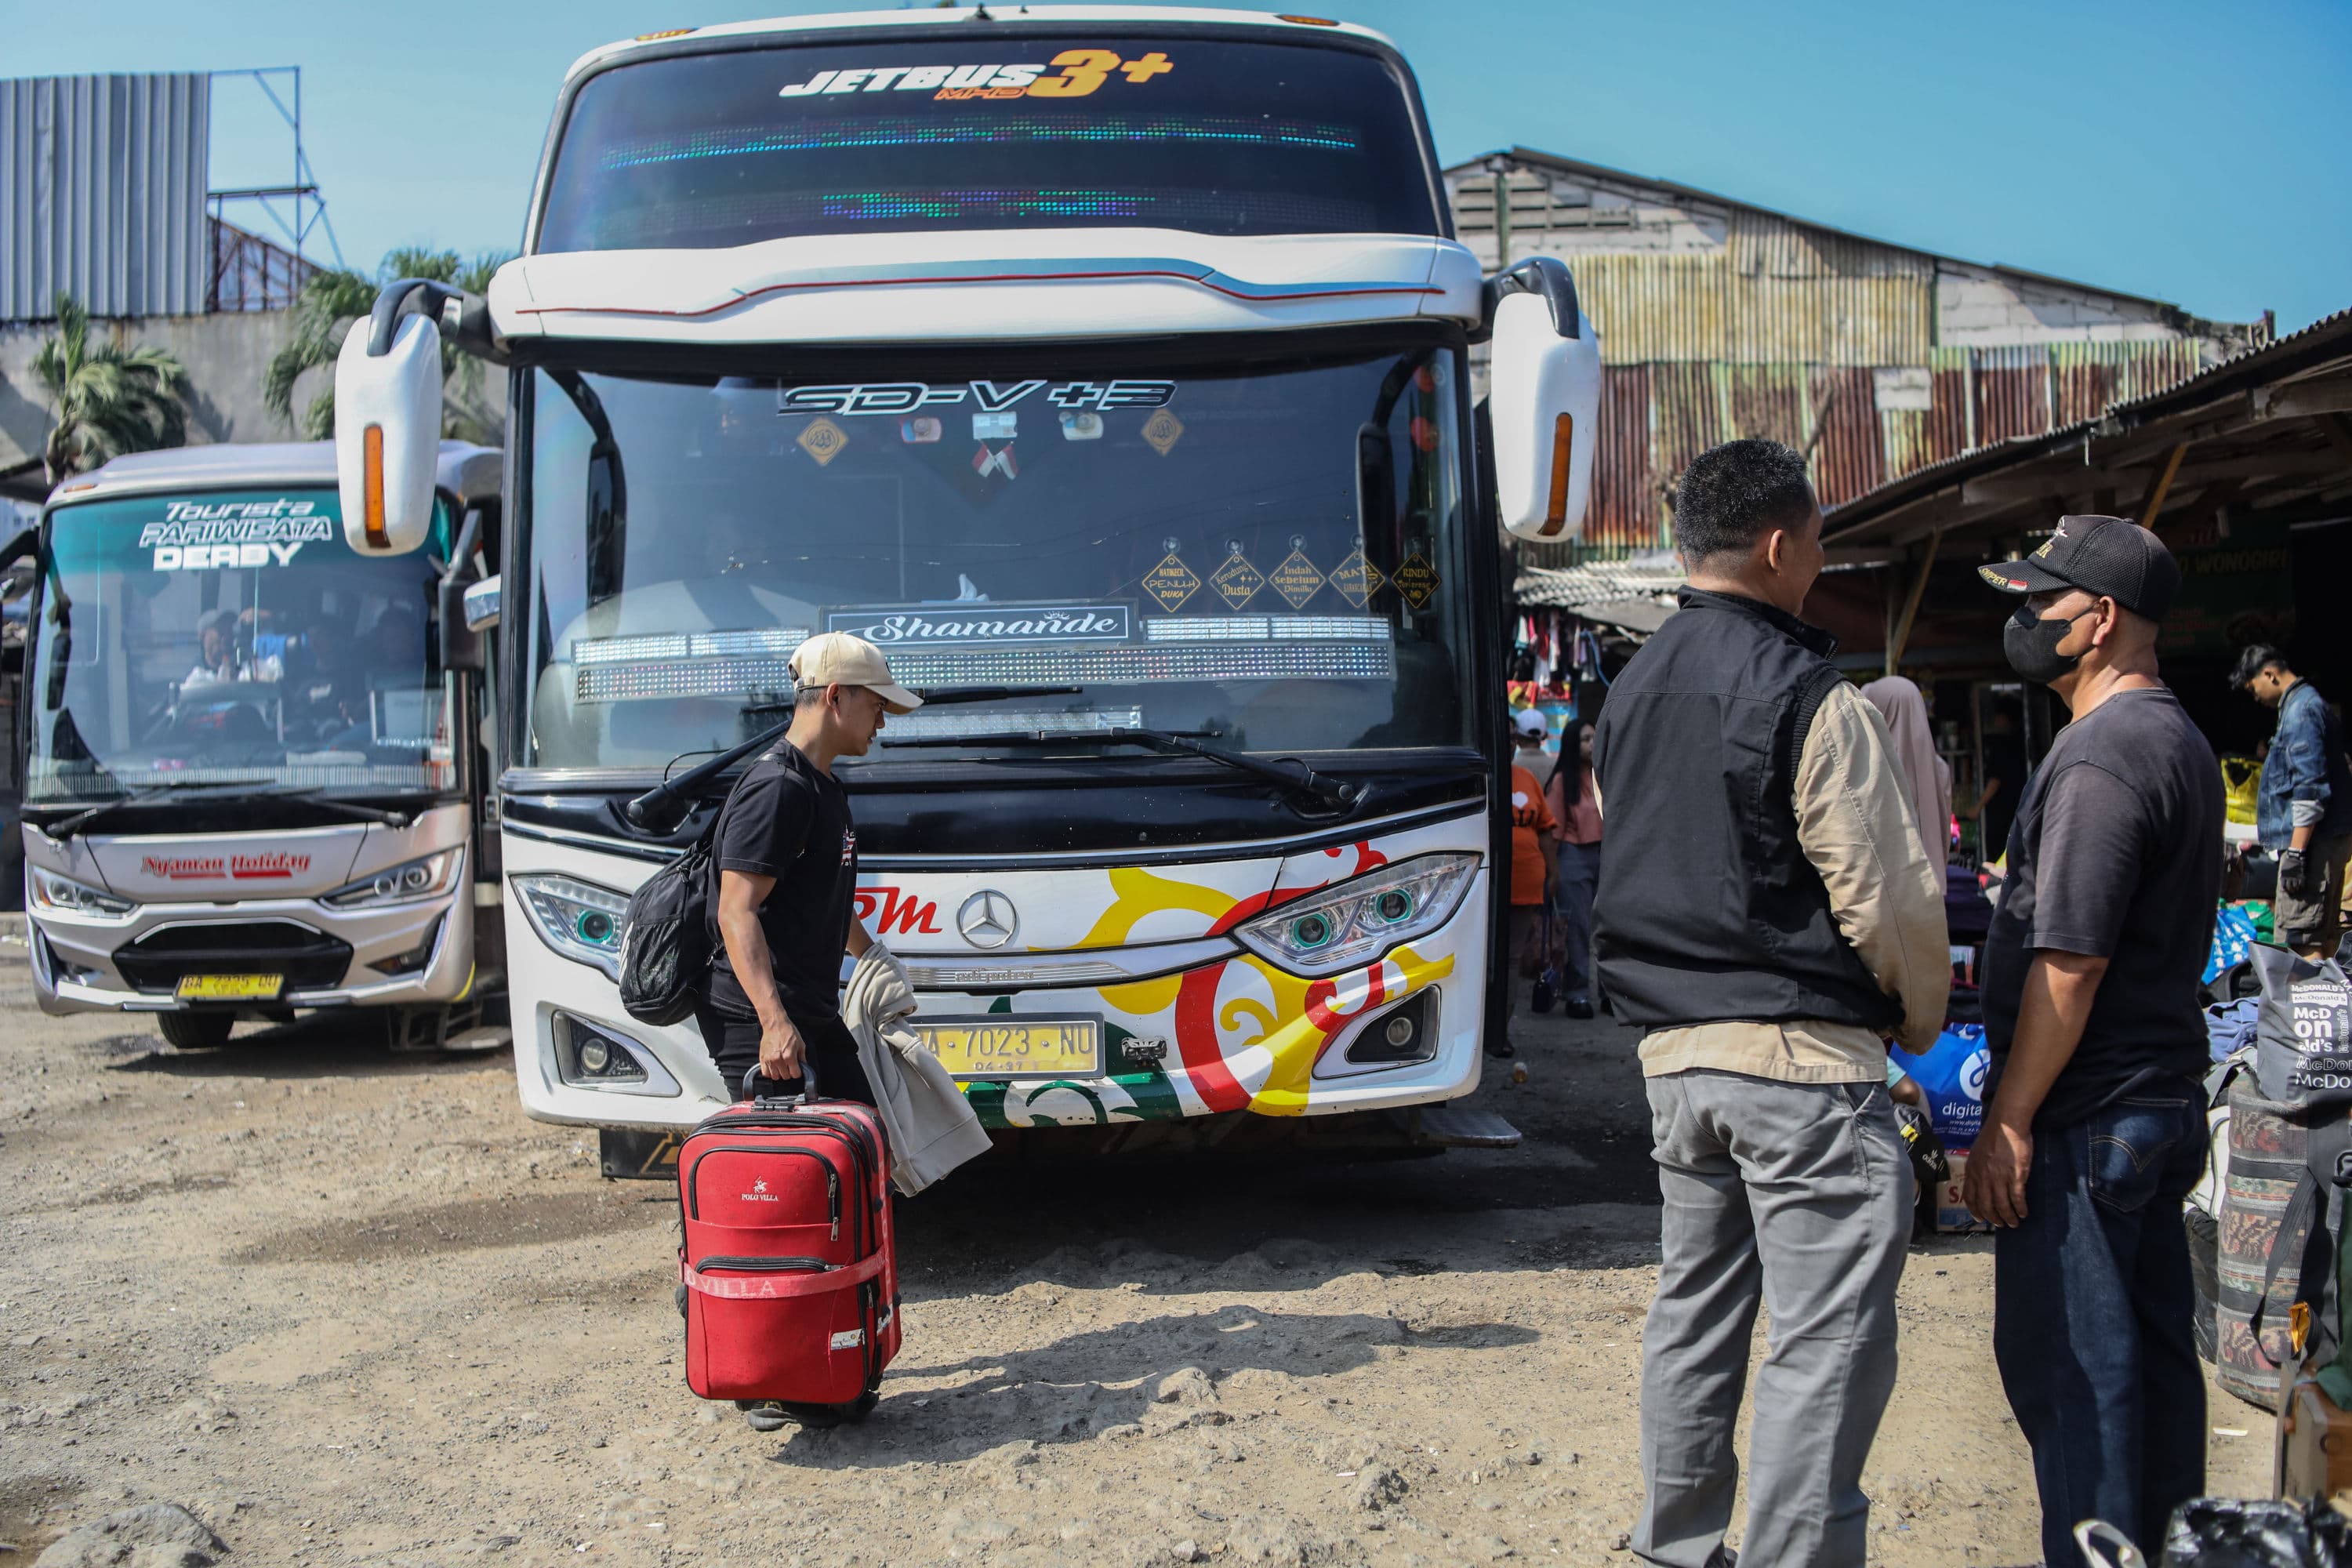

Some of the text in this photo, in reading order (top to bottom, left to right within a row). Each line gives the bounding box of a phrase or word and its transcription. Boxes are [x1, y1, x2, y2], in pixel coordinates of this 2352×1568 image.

[779, 49, 1174, 98] JETBUS 3+
[166, 498, 315, 521] Tourista
[139, 516, 332, 548] PARIWISATA
[1216, 564, 1249, 585] Kerudung
[1283, 566, 1312, 575] Indah
[1403, 568, 1429, 578] RINDU
[1222, 583, 1251, 597] Dusta
[850, 612, 1118, 642] Shamande
[142, 851, 311, 877] Nyaman Holiday
[2294, 1007, 2332, 1019] McD
[2294, 1020, 2332, 1038] on
[961, 1027, 1029, 1058] 7023
[1060, 1025, 1093, 1055] NU
[2296, 1056, 2352, 1071] McDo
[741, 1192, 779, 1202] POLO VILLA
[699, 1275, 778, 1298] VILLA
